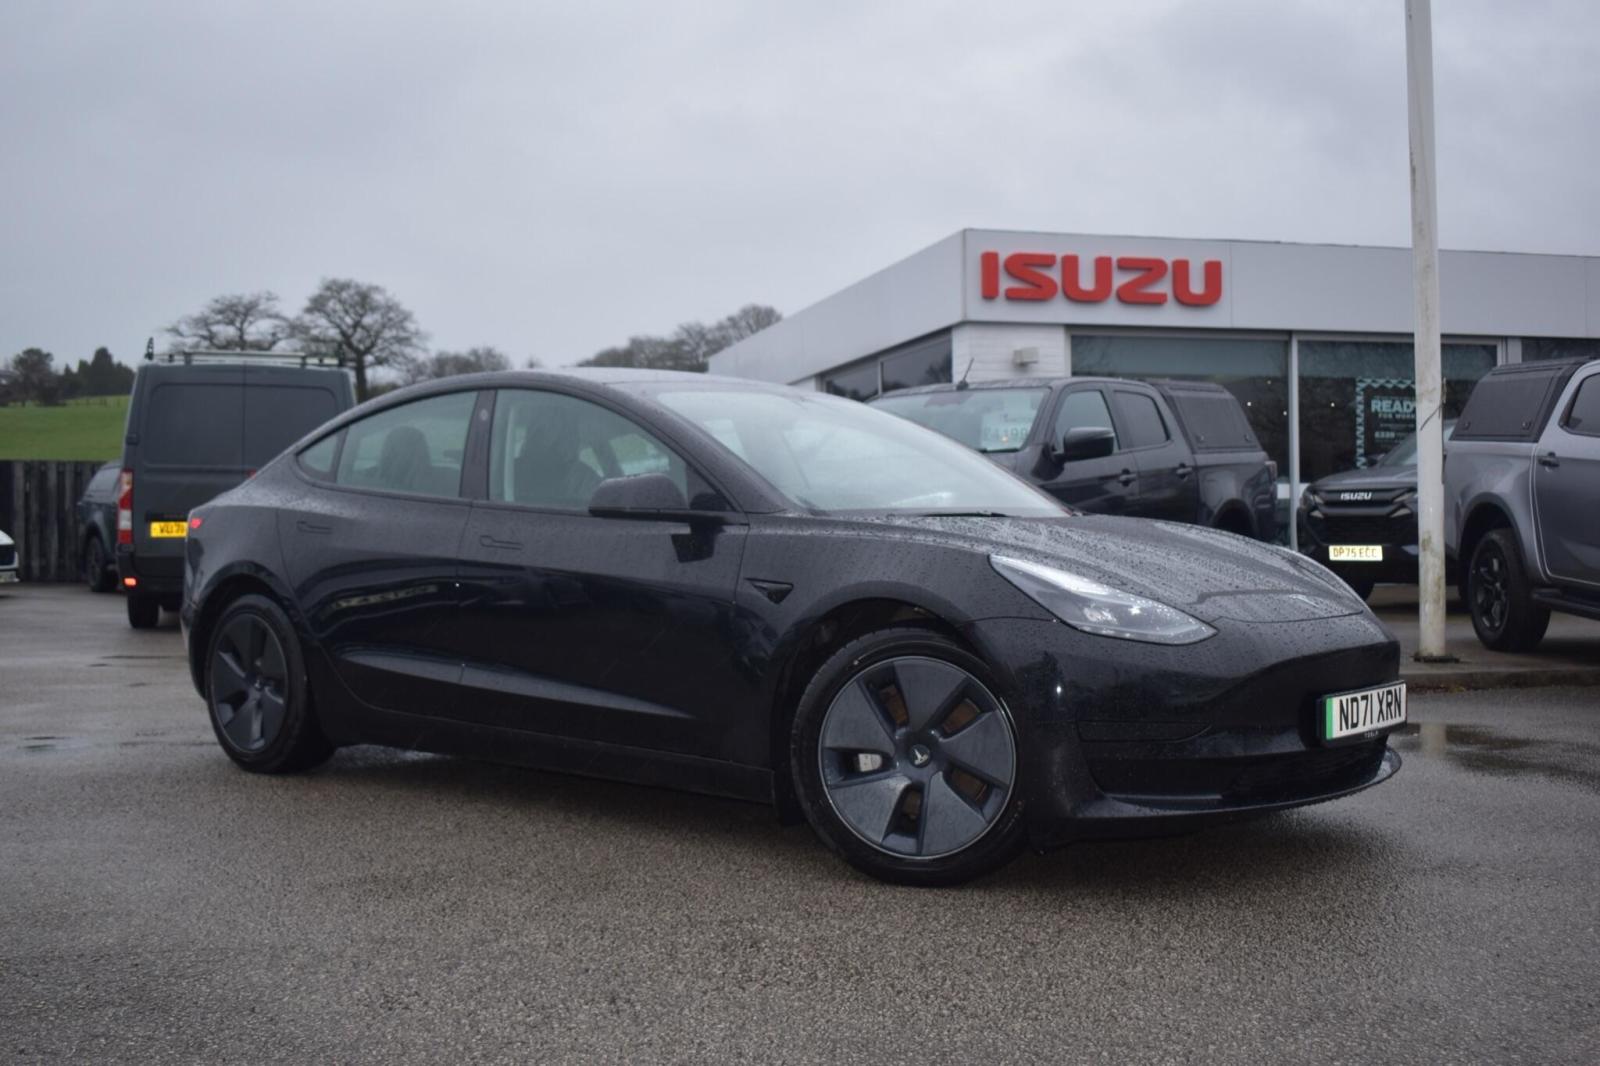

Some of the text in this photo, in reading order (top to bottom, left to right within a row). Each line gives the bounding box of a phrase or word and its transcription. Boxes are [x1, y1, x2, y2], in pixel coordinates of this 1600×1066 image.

[981, 252, 1222, 306] ISUZU
[1371, 399, 1416, 413] READ
[1340, 491, 1372, 501] ISUZU
[1339, 687, 1402, 731] ND71 XRN
